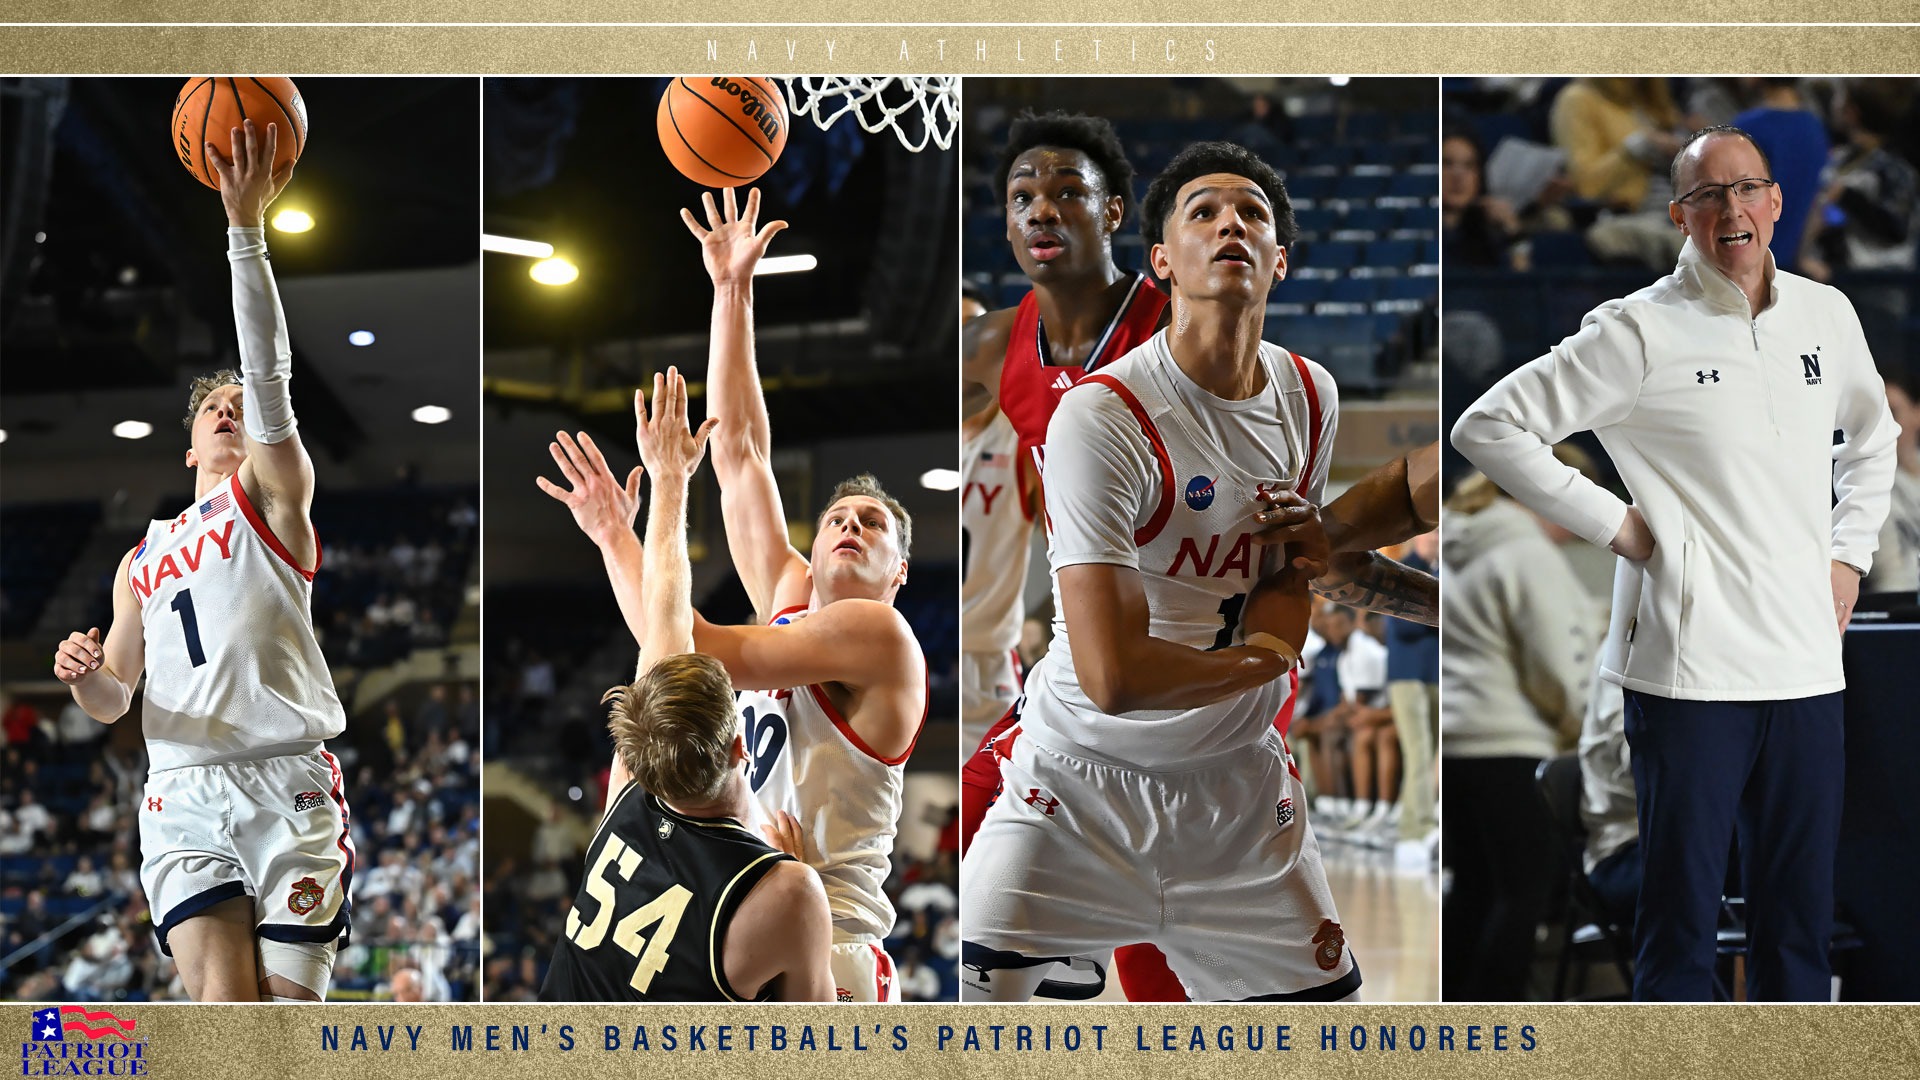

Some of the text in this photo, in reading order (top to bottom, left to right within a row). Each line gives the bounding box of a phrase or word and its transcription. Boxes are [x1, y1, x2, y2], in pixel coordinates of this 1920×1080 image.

[711, 77, 779, 144] Wilson
[1800, 354, 1821, 378] N
[1188, 489, 1213, 498] NASA
[132, 520, 235, 601] NAVY
[1167, 532, 1267, 578] NA
[171, 588, 207, 669] 1
[566, 832, 693, 994] 54
